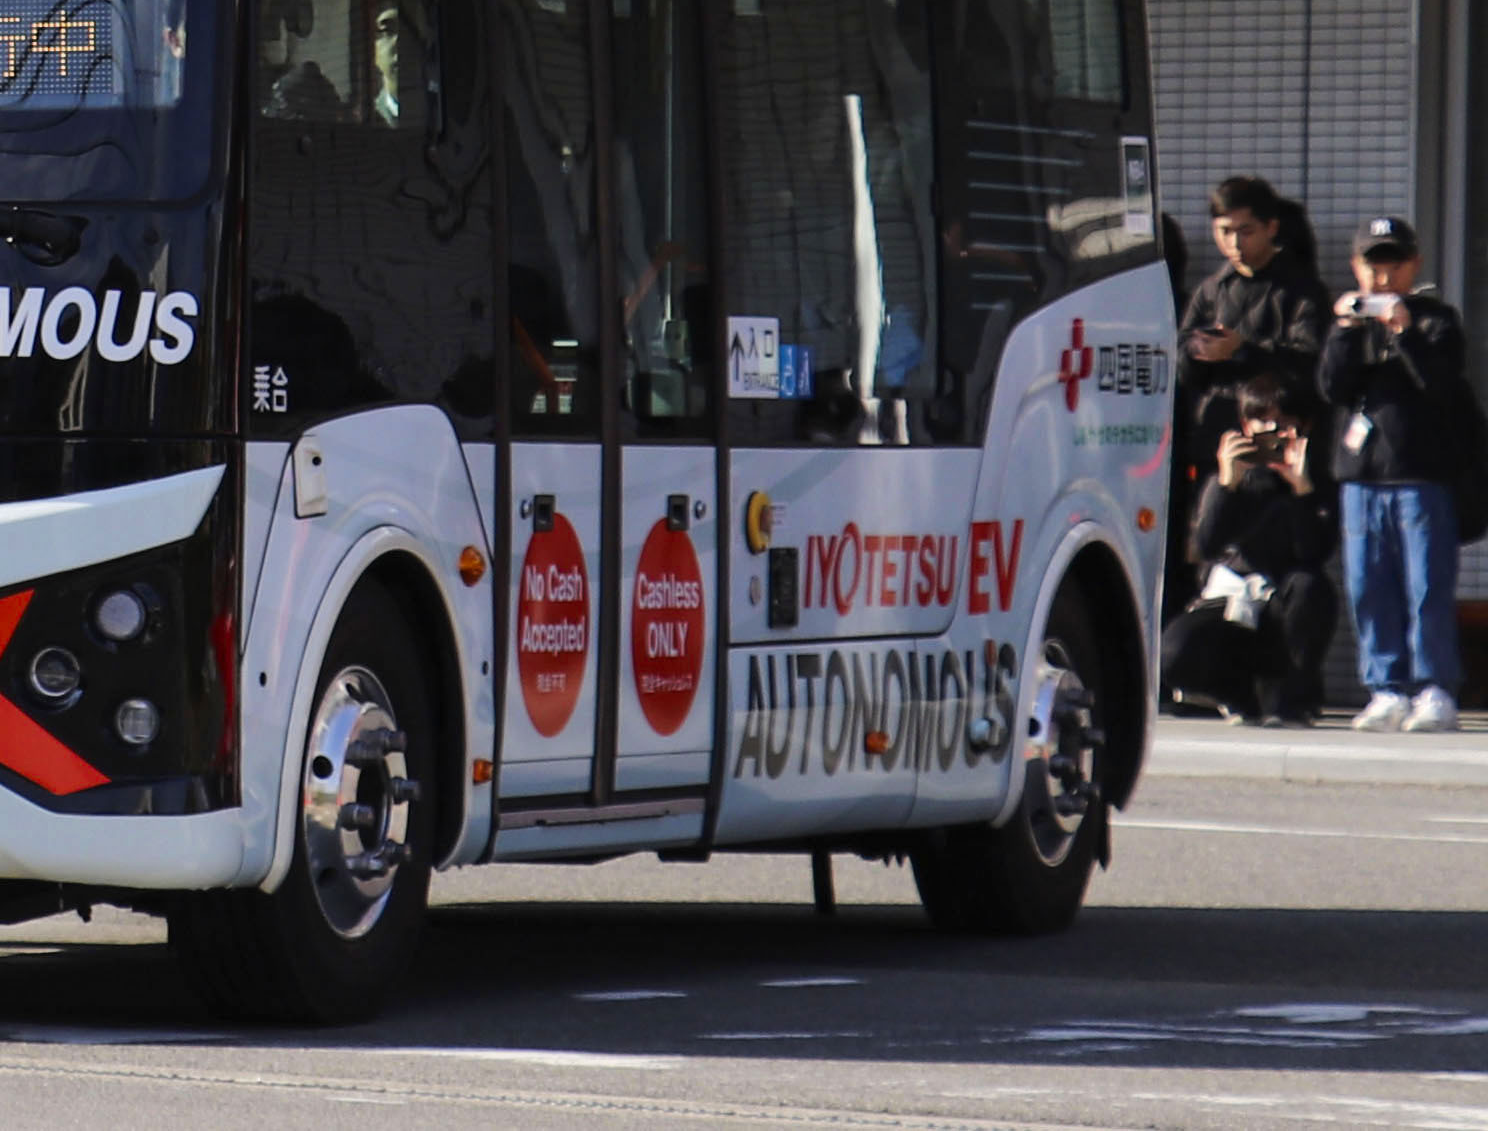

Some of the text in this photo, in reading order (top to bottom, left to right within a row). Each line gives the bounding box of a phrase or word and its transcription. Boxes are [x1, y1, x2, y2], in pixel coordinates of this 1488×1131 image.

[748, 327, 775, 358] 入口
[253, 365, 288, 412] 乗合
[1098, 343, 1169, 396] 四国電力
[526, 565, 583, 602] No Cash
[803, 518, 1024, 616] IYOTETSU EV
[637, 573, 700, 609] Cashless
[521, 616, 585, 657] Accepted
[647, 622, 689, 658] ONLY
[733, 643, 1020, 780] AUTONOMOUS
